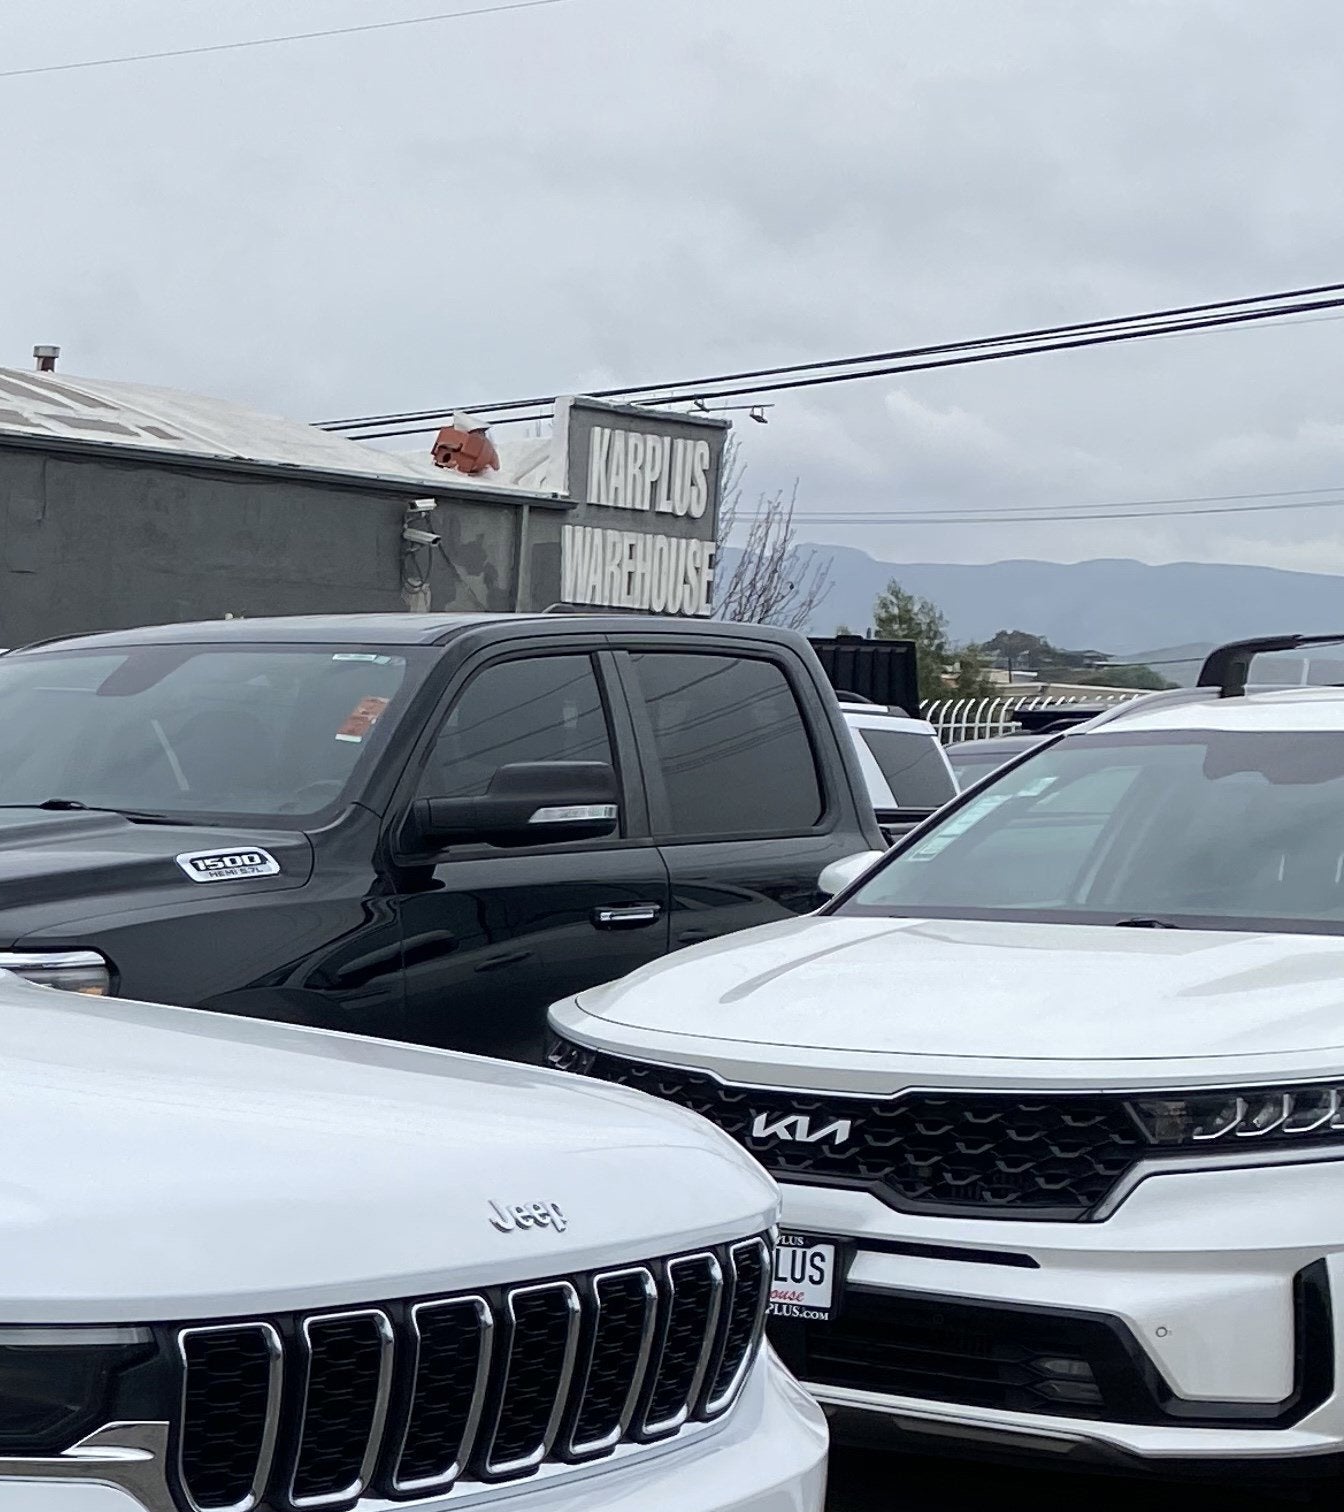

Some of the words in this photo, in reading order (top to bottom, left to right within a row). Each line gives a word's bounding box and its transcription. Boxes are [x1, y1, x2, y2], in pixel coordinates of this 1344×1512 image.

[587, 426, 710, 518] KARPLUS
[561, 525, 716, 616] WAREHOUSE
[192, 853, 262, 871] 1500
[208, 869, 239, 878] HEMI
[752, 1112, 852, 1145] KIA
[487, 1199, 568, 1233] Jeep
